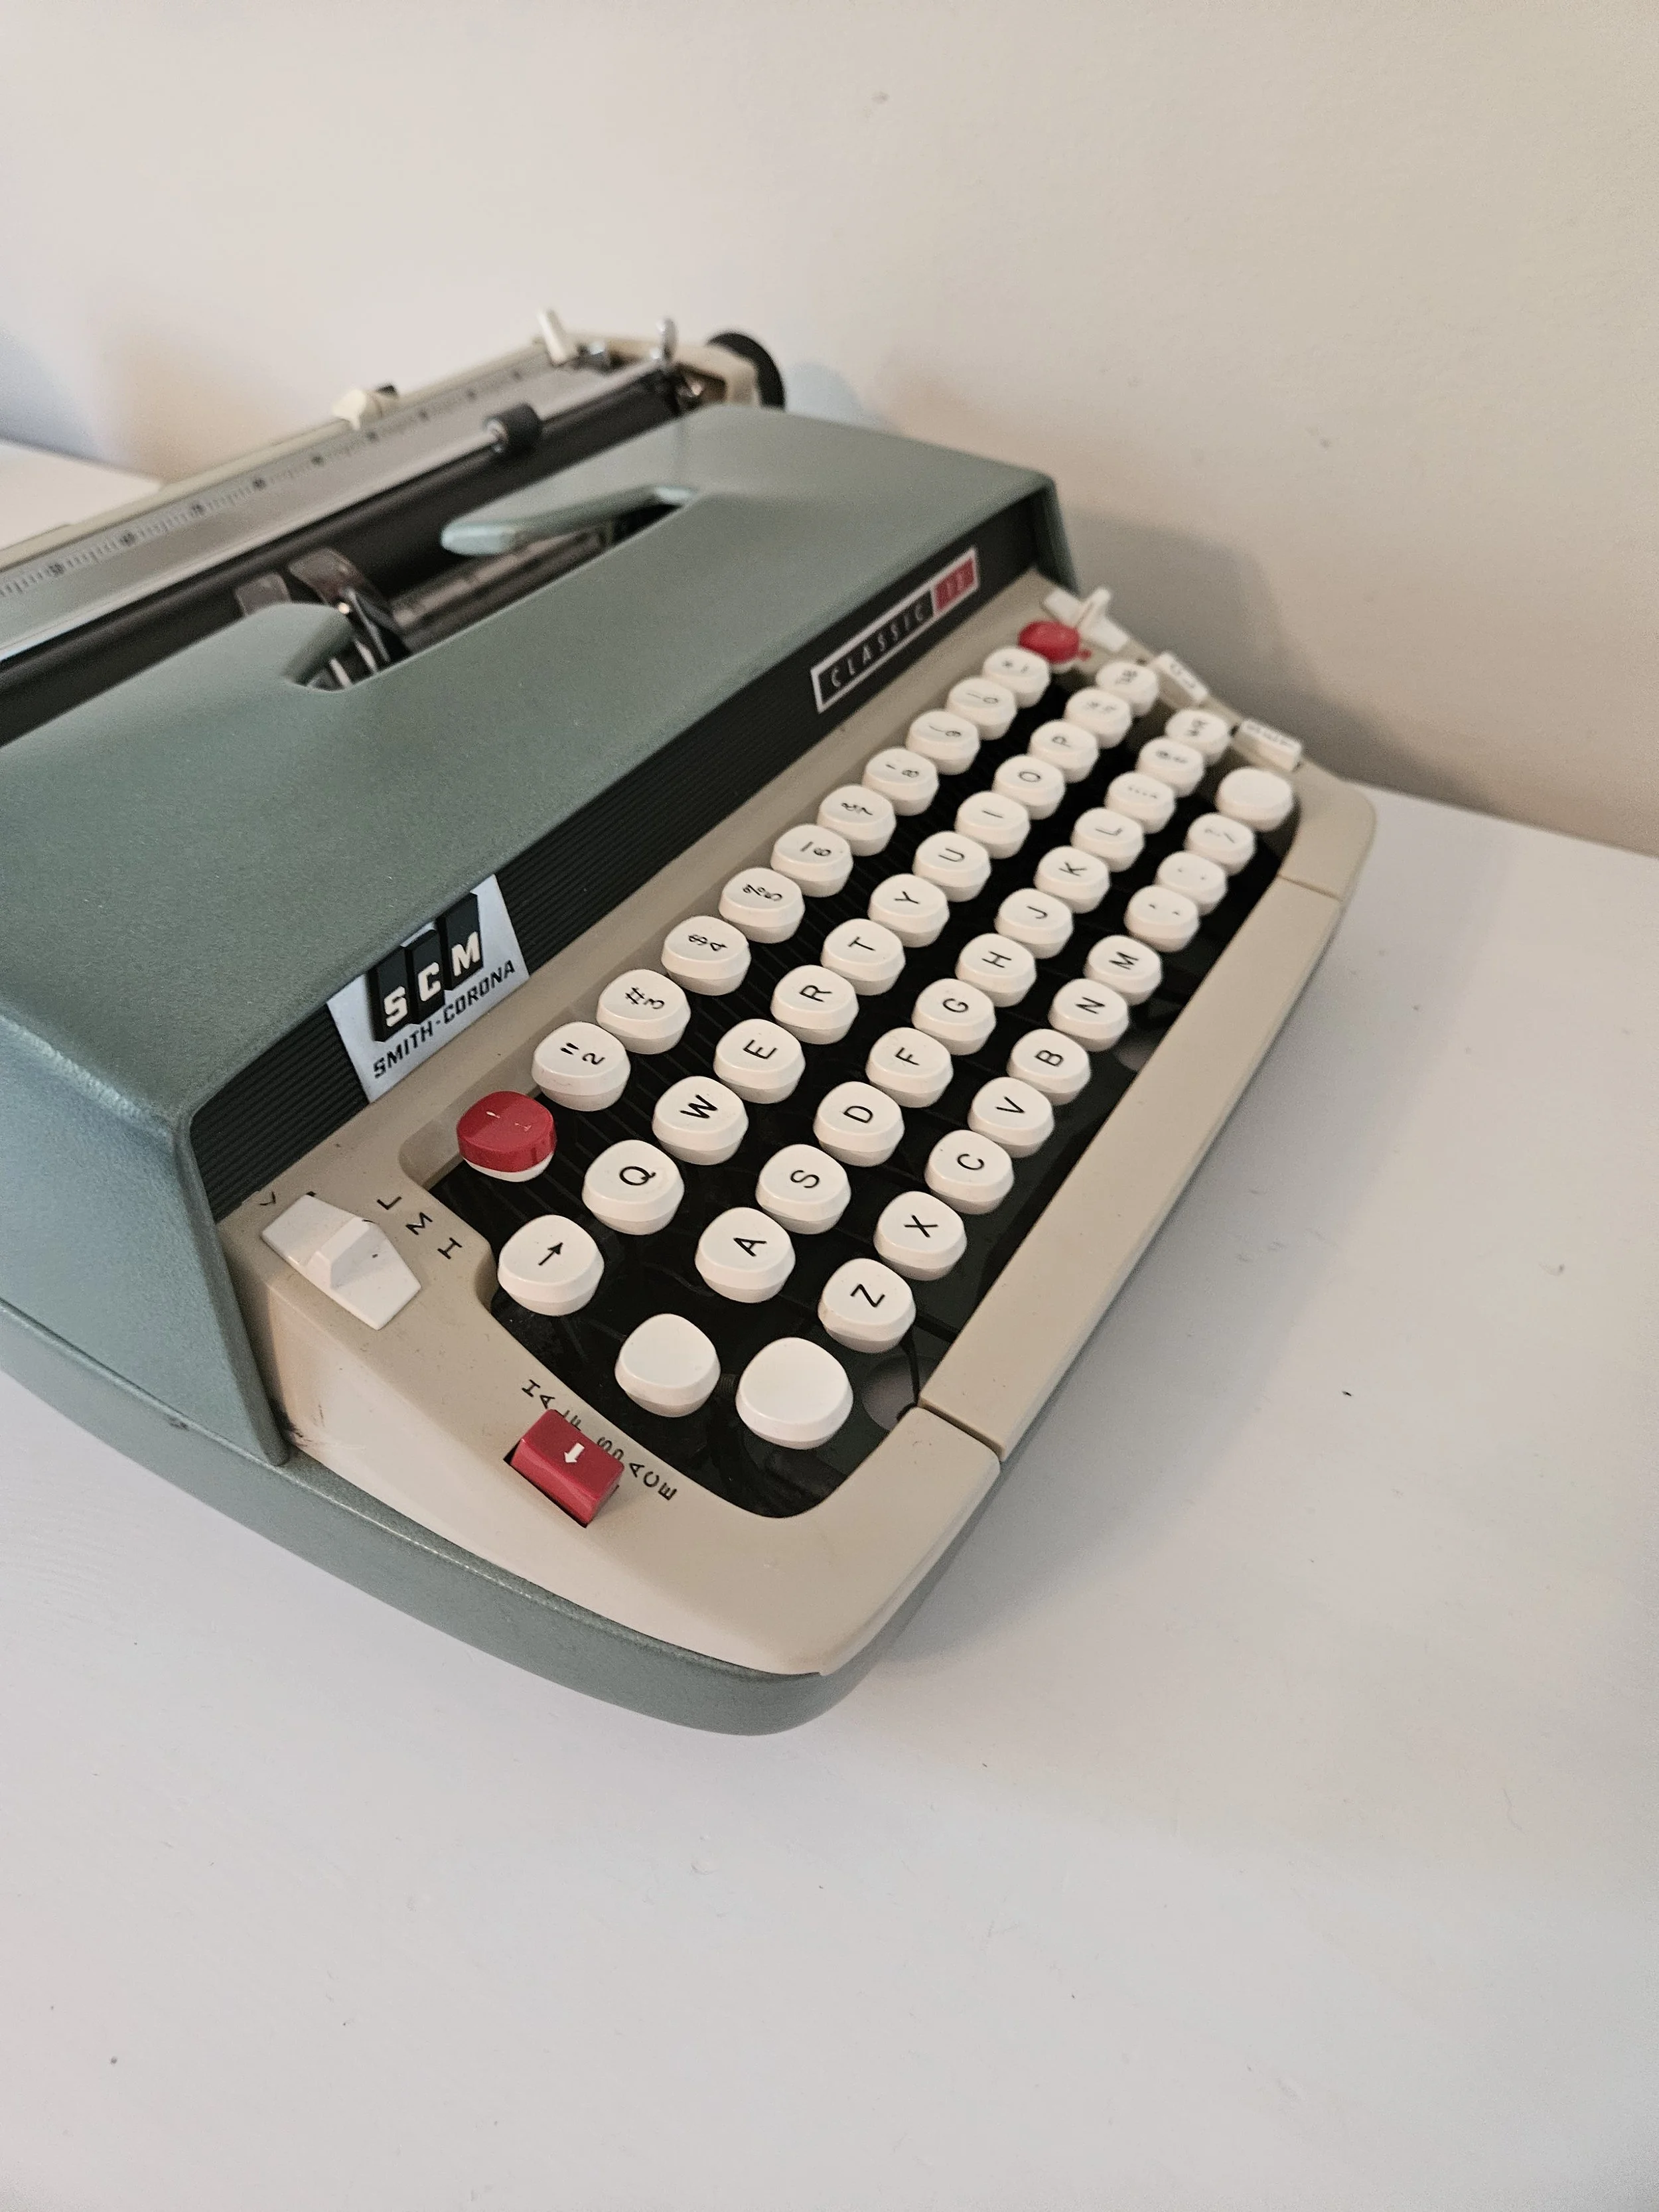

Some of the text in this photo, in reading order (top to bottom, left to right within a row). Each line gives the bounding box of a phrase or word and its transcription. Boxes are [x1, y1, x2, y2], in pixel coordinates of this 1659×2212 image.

[831, 601, 925, 688] CLASSIC
[1052, 736, 1070, 747] P
[939, 848, 965, 862] U
[1059, 862, 1086, 877] K
[895, 891, 918, 904] Y
[1027, 906, 1048, 919] J
[709, 942, 727, 951] 4
[849, 937, 875, 950] T
[982, 952, 1011, 968] H
[1110, 951, 1139, 970] M
[384, 931, 480, 1027] SCM
[800, 985, 831, 1002] R
[644, 999, 664, 1009] 3
[943, 998, 968, 1013] G
[1076, 997, 1106, 1014] N
[373, 960, 516, 1079] SMITH-CORONA
[743, 1039, 777, 1060] E
[895, 1047, 918, 1065] F
[1035, 1050, 1063, 1066] B
[582, 1053, 605, 1065] 2
[680, 1093, 718, 1119] W
[996, 1097, 1025, 1113] V
[843, 1106, 873, 1123] D
[957, 1154, 984, 1170] C
[619, 1166, 656, 1185] Q
[790, 1170, 820, 1188] S
[377, 1197, 401, 1210] L
[405, 1213, 433, 1235] M
[904, 1215, 938, 1238] X
[437, 1238, 462, 1259] H
[733, 1235, 767, 1257] A
[850, 1284, 885, 1307] Z
